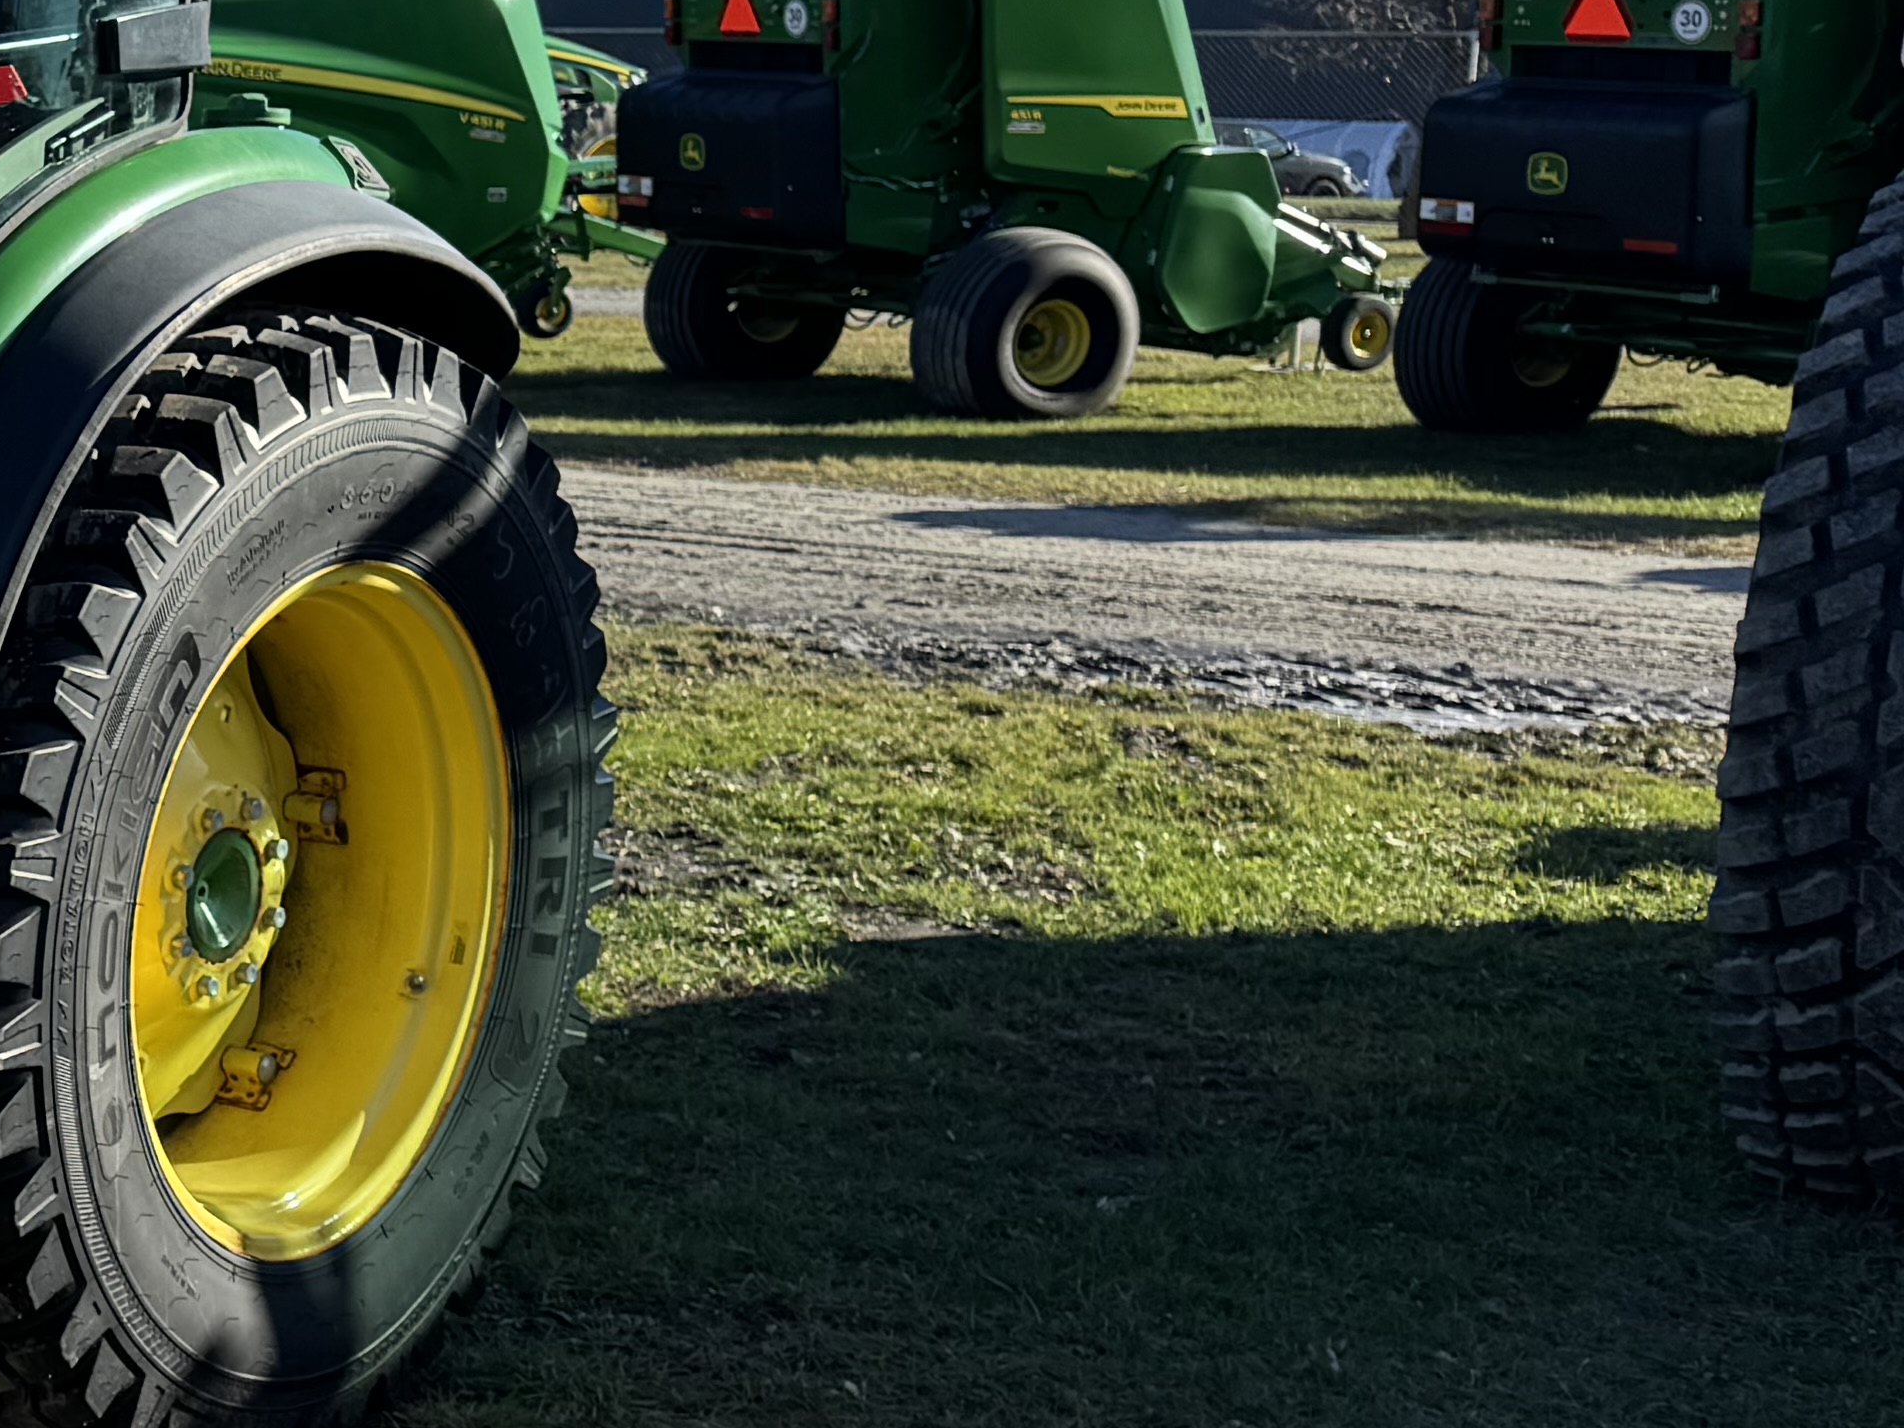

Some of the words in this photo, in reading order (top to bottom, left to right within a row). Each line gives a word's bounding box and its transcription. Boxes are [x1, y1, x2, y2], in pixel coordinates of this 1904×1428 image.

[1680, 10, 1702, 28] 30
[59, 812, 95, 986] ROTATION
[530, 788, 570, 960] TRI
